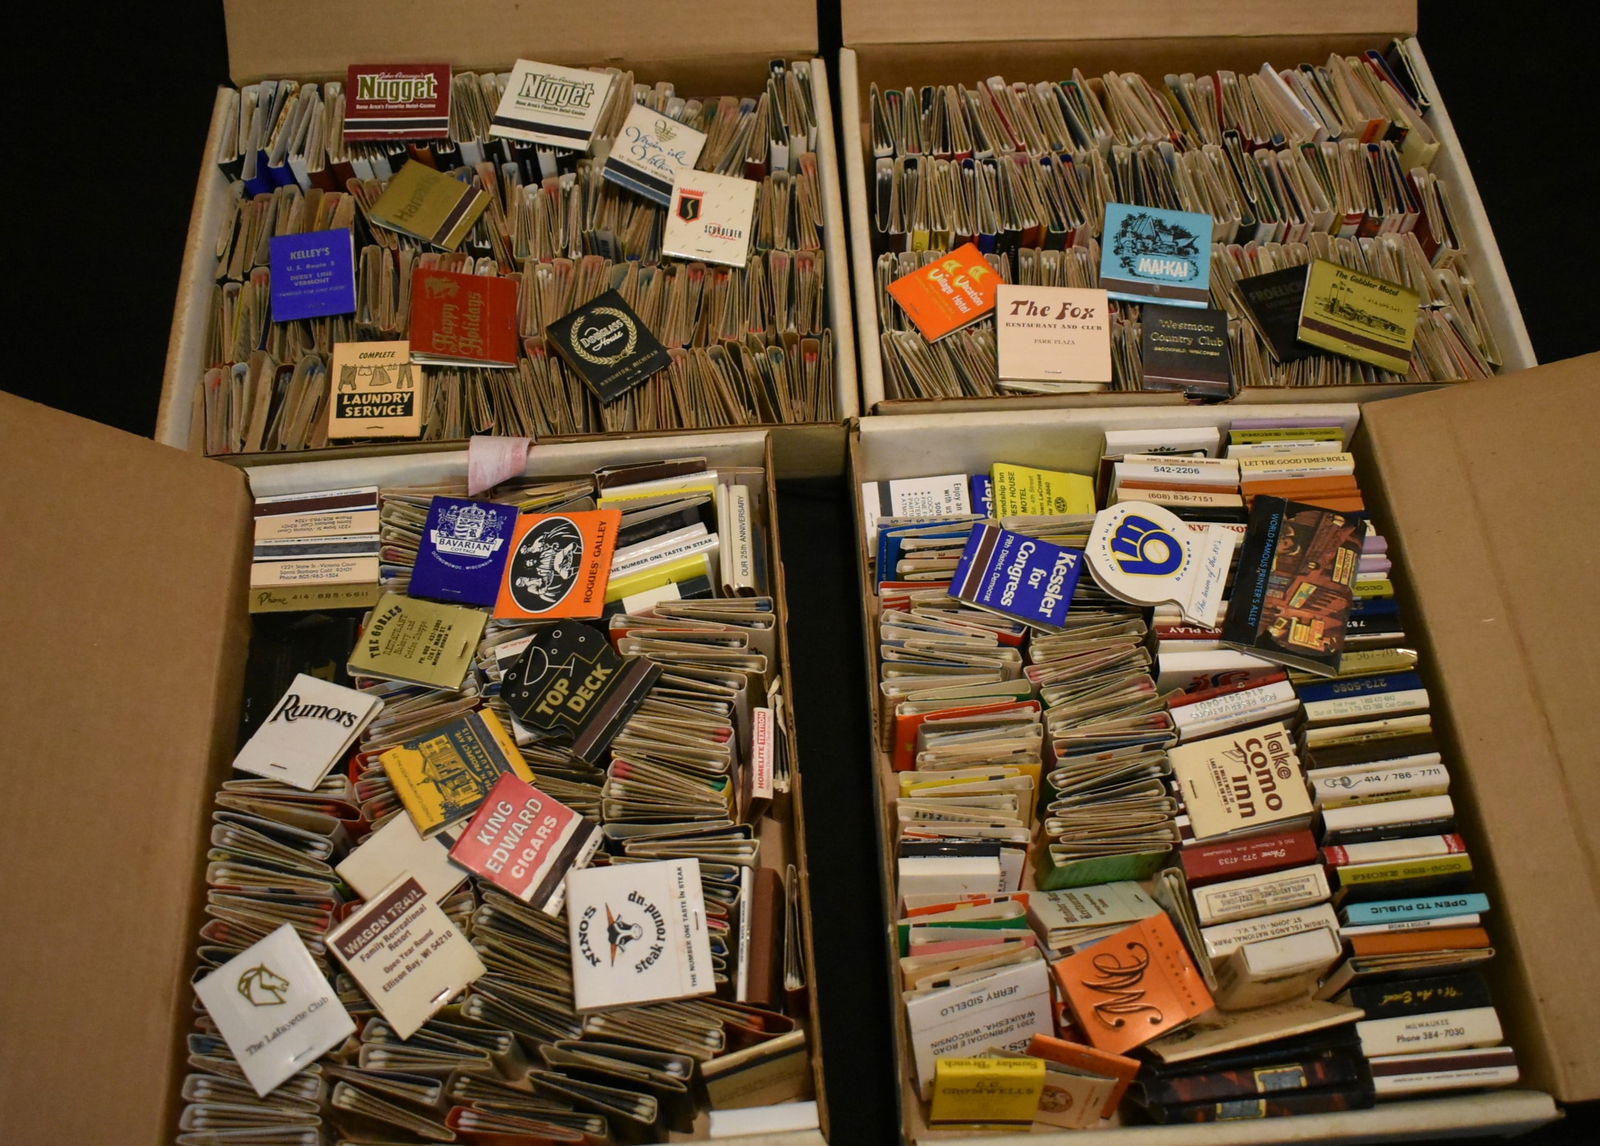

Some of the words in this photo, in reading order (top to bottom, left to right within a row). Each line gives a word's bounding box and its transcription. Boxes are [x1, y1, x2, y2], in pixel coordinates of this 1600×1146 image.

[356, 73, 438, 104] Nugget
[518, 72, 594, 109] Nugget
[290, 248, 330, 260] KELLEY'S
[1336, 270, 1348, 280] The
[1378, 284, 1400, 296] Motel
[952, 294, 970, 313] Hotel
[1010, 300, 1050, 316] The
[1056, 302, 1095, 320] Fox
[432, 304, 459, 353] Happy
[459, 292, 485, 356] Holidays
[1150, 332, 1193, 345] Country
[1198, 336, 1224, 346] Club
[343, 392, 411, 404] LAUNDRY
[345, 405, 404, 416] SERVICE
[1153, 466, 1200, 475] 542-2206
[954, 482, 962, 501] Enjoy
[1008, 472, 1017, 498] HOUSE
[956, 502, 962, 511] an
[1020, 488, 1028, 513] MOTEL
[739, 496, 748, 546] ANNIVERSARY
[1270, 513, 1280, 540] WORLD
[439, 538, 490, 551] BAVARIAN
[621, 558, 648, 572] NUMBER
[650, 552, 662, 562] ONE
[664, 547, 683, 558] TASTE
[692, 538, 712, 550] STEAK
[1264, 540, 1274, 570] FAMOUS
[584, 560, 600, 604] ROGUES'
[593, 520, 607, 559] GALLEY
[1000, 542, 1036, 606] Congress
[984, 572, 1000, 602] Democrat
[1028, 568, 1047, 590] for
[1038, 552, 1078, 618] Kessler
[1254, 570, 1267, 604] PRINTER'S
[371, 605, 402, 636] GOBLES
[1248, 604, 1256, 628] ALLEY
[369, 640, 380, 659] THE
[536, 678, 570, 718] TOP
[567, 664, 612, 714] DECK
[270, 694, 358, 728] Rumors
[758, 711, 766, 744] TEXTRON
[462, 744, 482, 772] PROSPECT
[757, 744, 765, 789] HOMELITE
[1264, 732, 1292, 780] lake
[1246, 738, 1282, 812] como
[1364, 774, 1380, 783] 414
[1232, 774, 1257, 818] inn
[477, 800, 514, 846] KING
[485, 797, 542, 874] EDWARD
[512, 814, 558, 878] CIGARS
[680, 890, 687, 900] IN
[1435, 899, 1468, 908] OPEN
[345, 916, 389, 955] WAGON
[388, 888, 424, 920] TRAIL
[627, 890, 666, 942] round-up
[1304, 918, 1330, 928] VIRGIN
[1370, 905, 1413, 914] PUBLIC
[360, 940, 385, 962] Family
[384, 904, 428, 944] Recreational
[578, 904, 602, 967] NINO'S
[1270, 919, 1290, 928] JOHN
[1270, 924, 1303, 936] ISLANDS
[383, 957, 399, 973] Open
[398, 945, 414, 962] Year
[414, 929, 434, 948] Round
[388, 930, 412, 952] Resort
[1214, 938, 1232, 946] PARK
[1234, 931, 1270, 944] NATIONAL
[382, 972, 408, 992] Ellison
[405, 957, 424, 975] Bay,
[422, 948, 432, 959] WI
[430, 929, 454, 952] 54210
[634, 943, 664, 974] steak
[686, 940, 696, 973] NUMBER
[940, 996, 984, 1016] SIDELLO
[986, 984, 1020, 1001] JERRY
[245, 1038, 266, 1056] The
[265, 1010, 308, 1044] Lafayette
[308, 995, 330, 1014] Club
[982, 1010, 1036, 1031] WAUKESHA,
[1016, 1018, 1036, 1029] 2301
[1404, 1018, 1450, 1030] MILWAUKEE
[930, 1028, 982, 1048] WISCONSIN
[1396, 1034, 1421, 1043] Phone
[1422, 1027, 1465, 1040] 384-7030
[932, 1043, 958, 1056] ROAD
